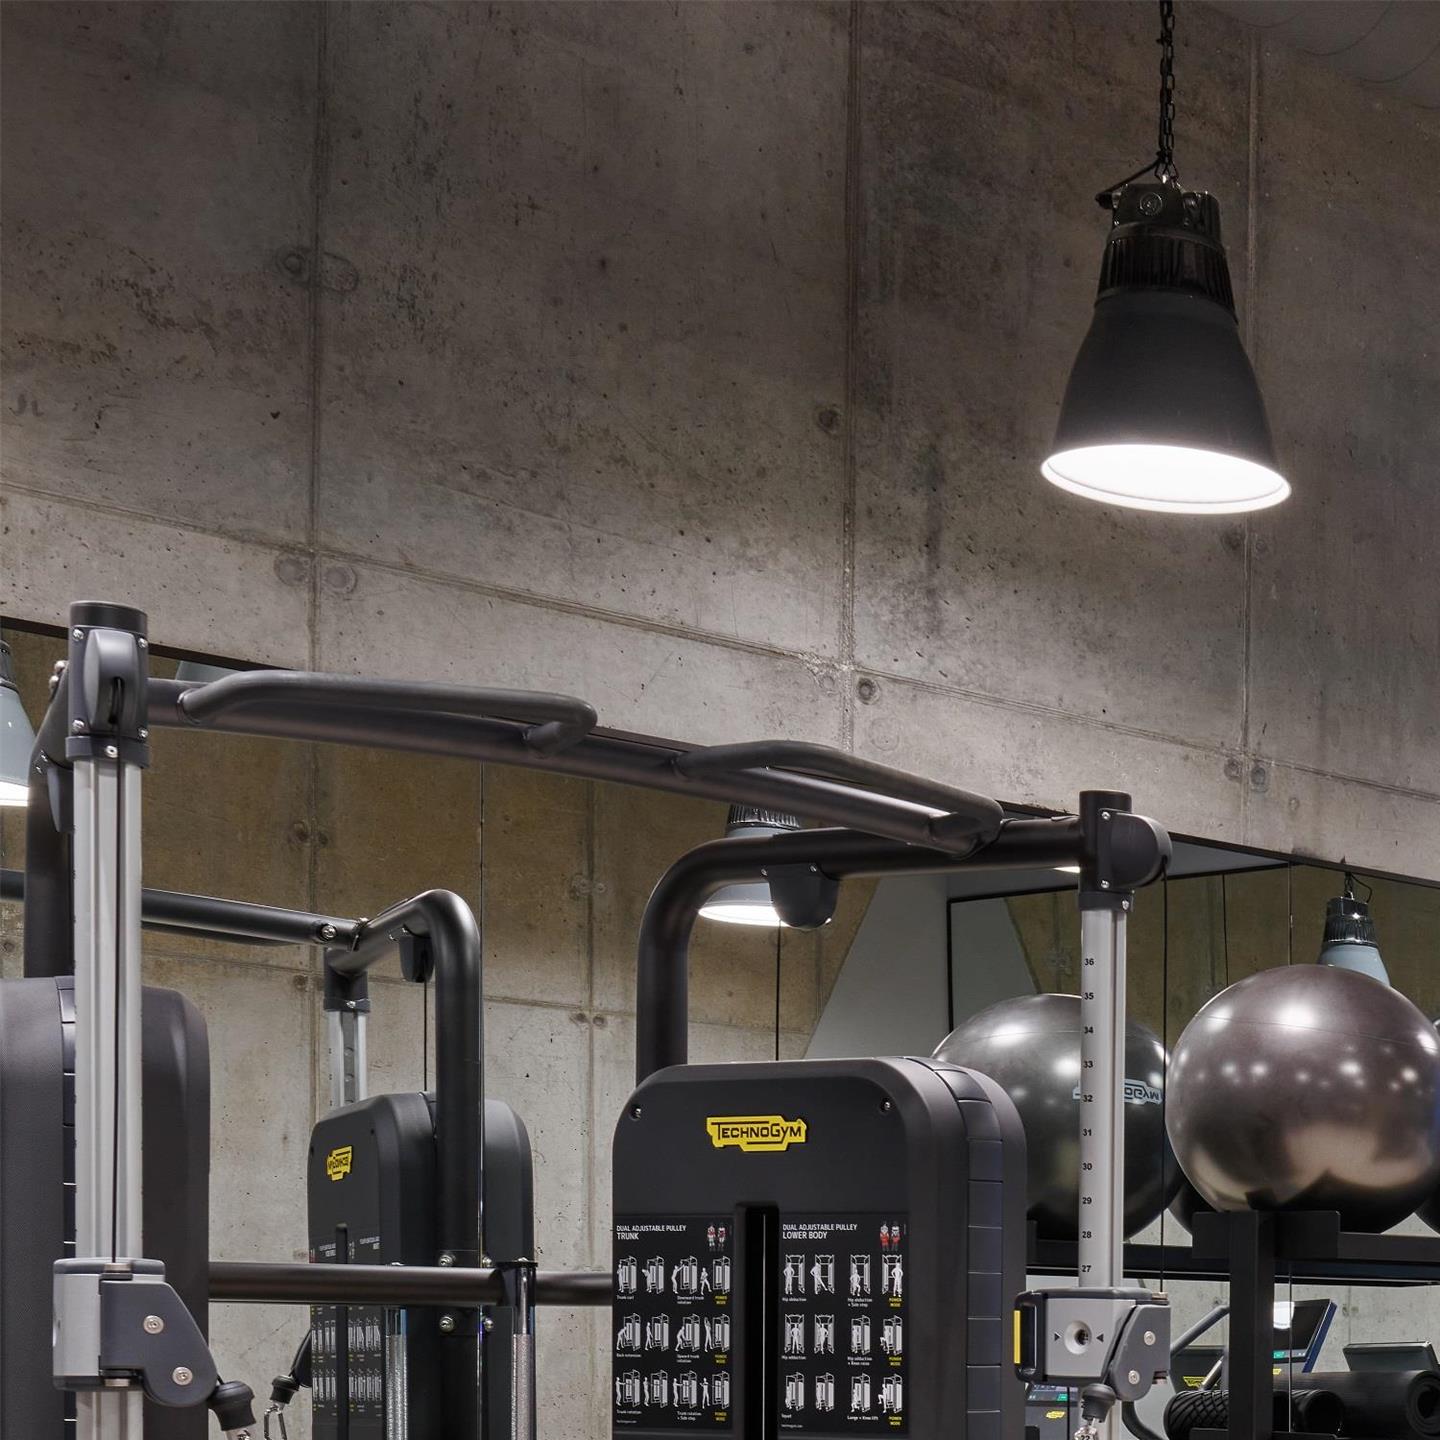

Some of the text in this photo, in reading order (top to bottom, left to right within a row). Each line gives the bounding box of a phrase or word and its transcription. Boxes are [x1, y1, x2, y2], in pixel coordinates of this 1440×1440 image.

[1084, 958, 1094, 966] 36
[1084, 992, 1094, 1000] 35
[1084, 1026, 1094, 1034] 34
[1084, 1060, 1094, 1068] 33
[1083, 1094, 1093, 1102] 32
[711, 1120, 803, 1145] TECHNOGYM
[1082, 1128, 1092, 1136] 31
[1082, 1162, 1092, 1170] 30
[1082, 1196, 1092, 1204] 29
[617, 1232, 639, 1240] TRUNK
[1082, 1230, 1092, 1238] 28
[1081, 1265, 1091, 1273] 27
